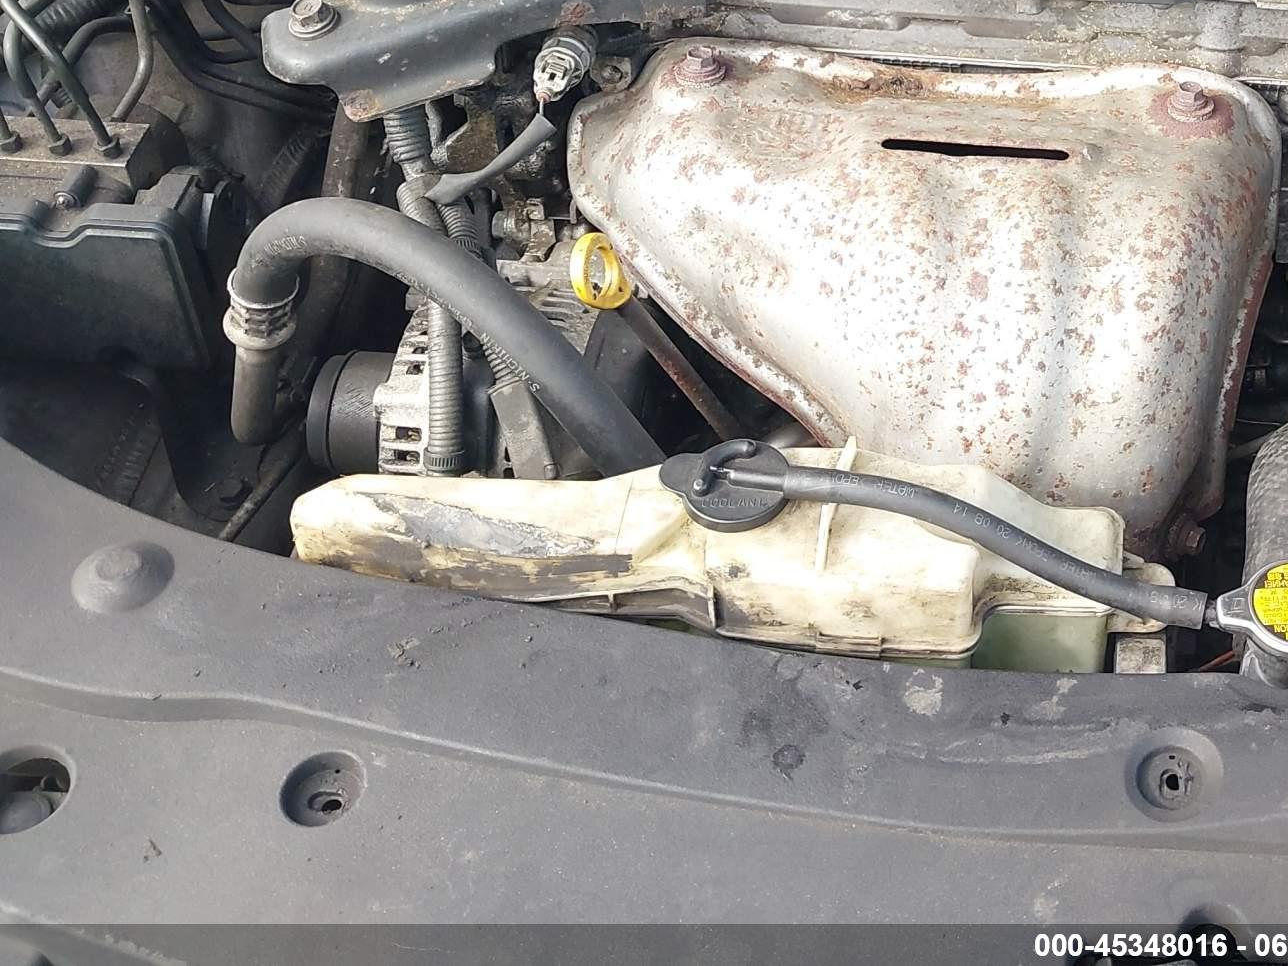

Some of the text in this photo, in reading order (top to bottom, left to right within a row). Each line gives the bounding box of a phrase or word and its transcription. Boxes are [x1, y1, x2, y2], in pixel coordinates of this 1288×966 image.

[953, 503, 968, 518] 14
[974, 513, 991, 529] 08
[996, 524, 1012, 540] 20
